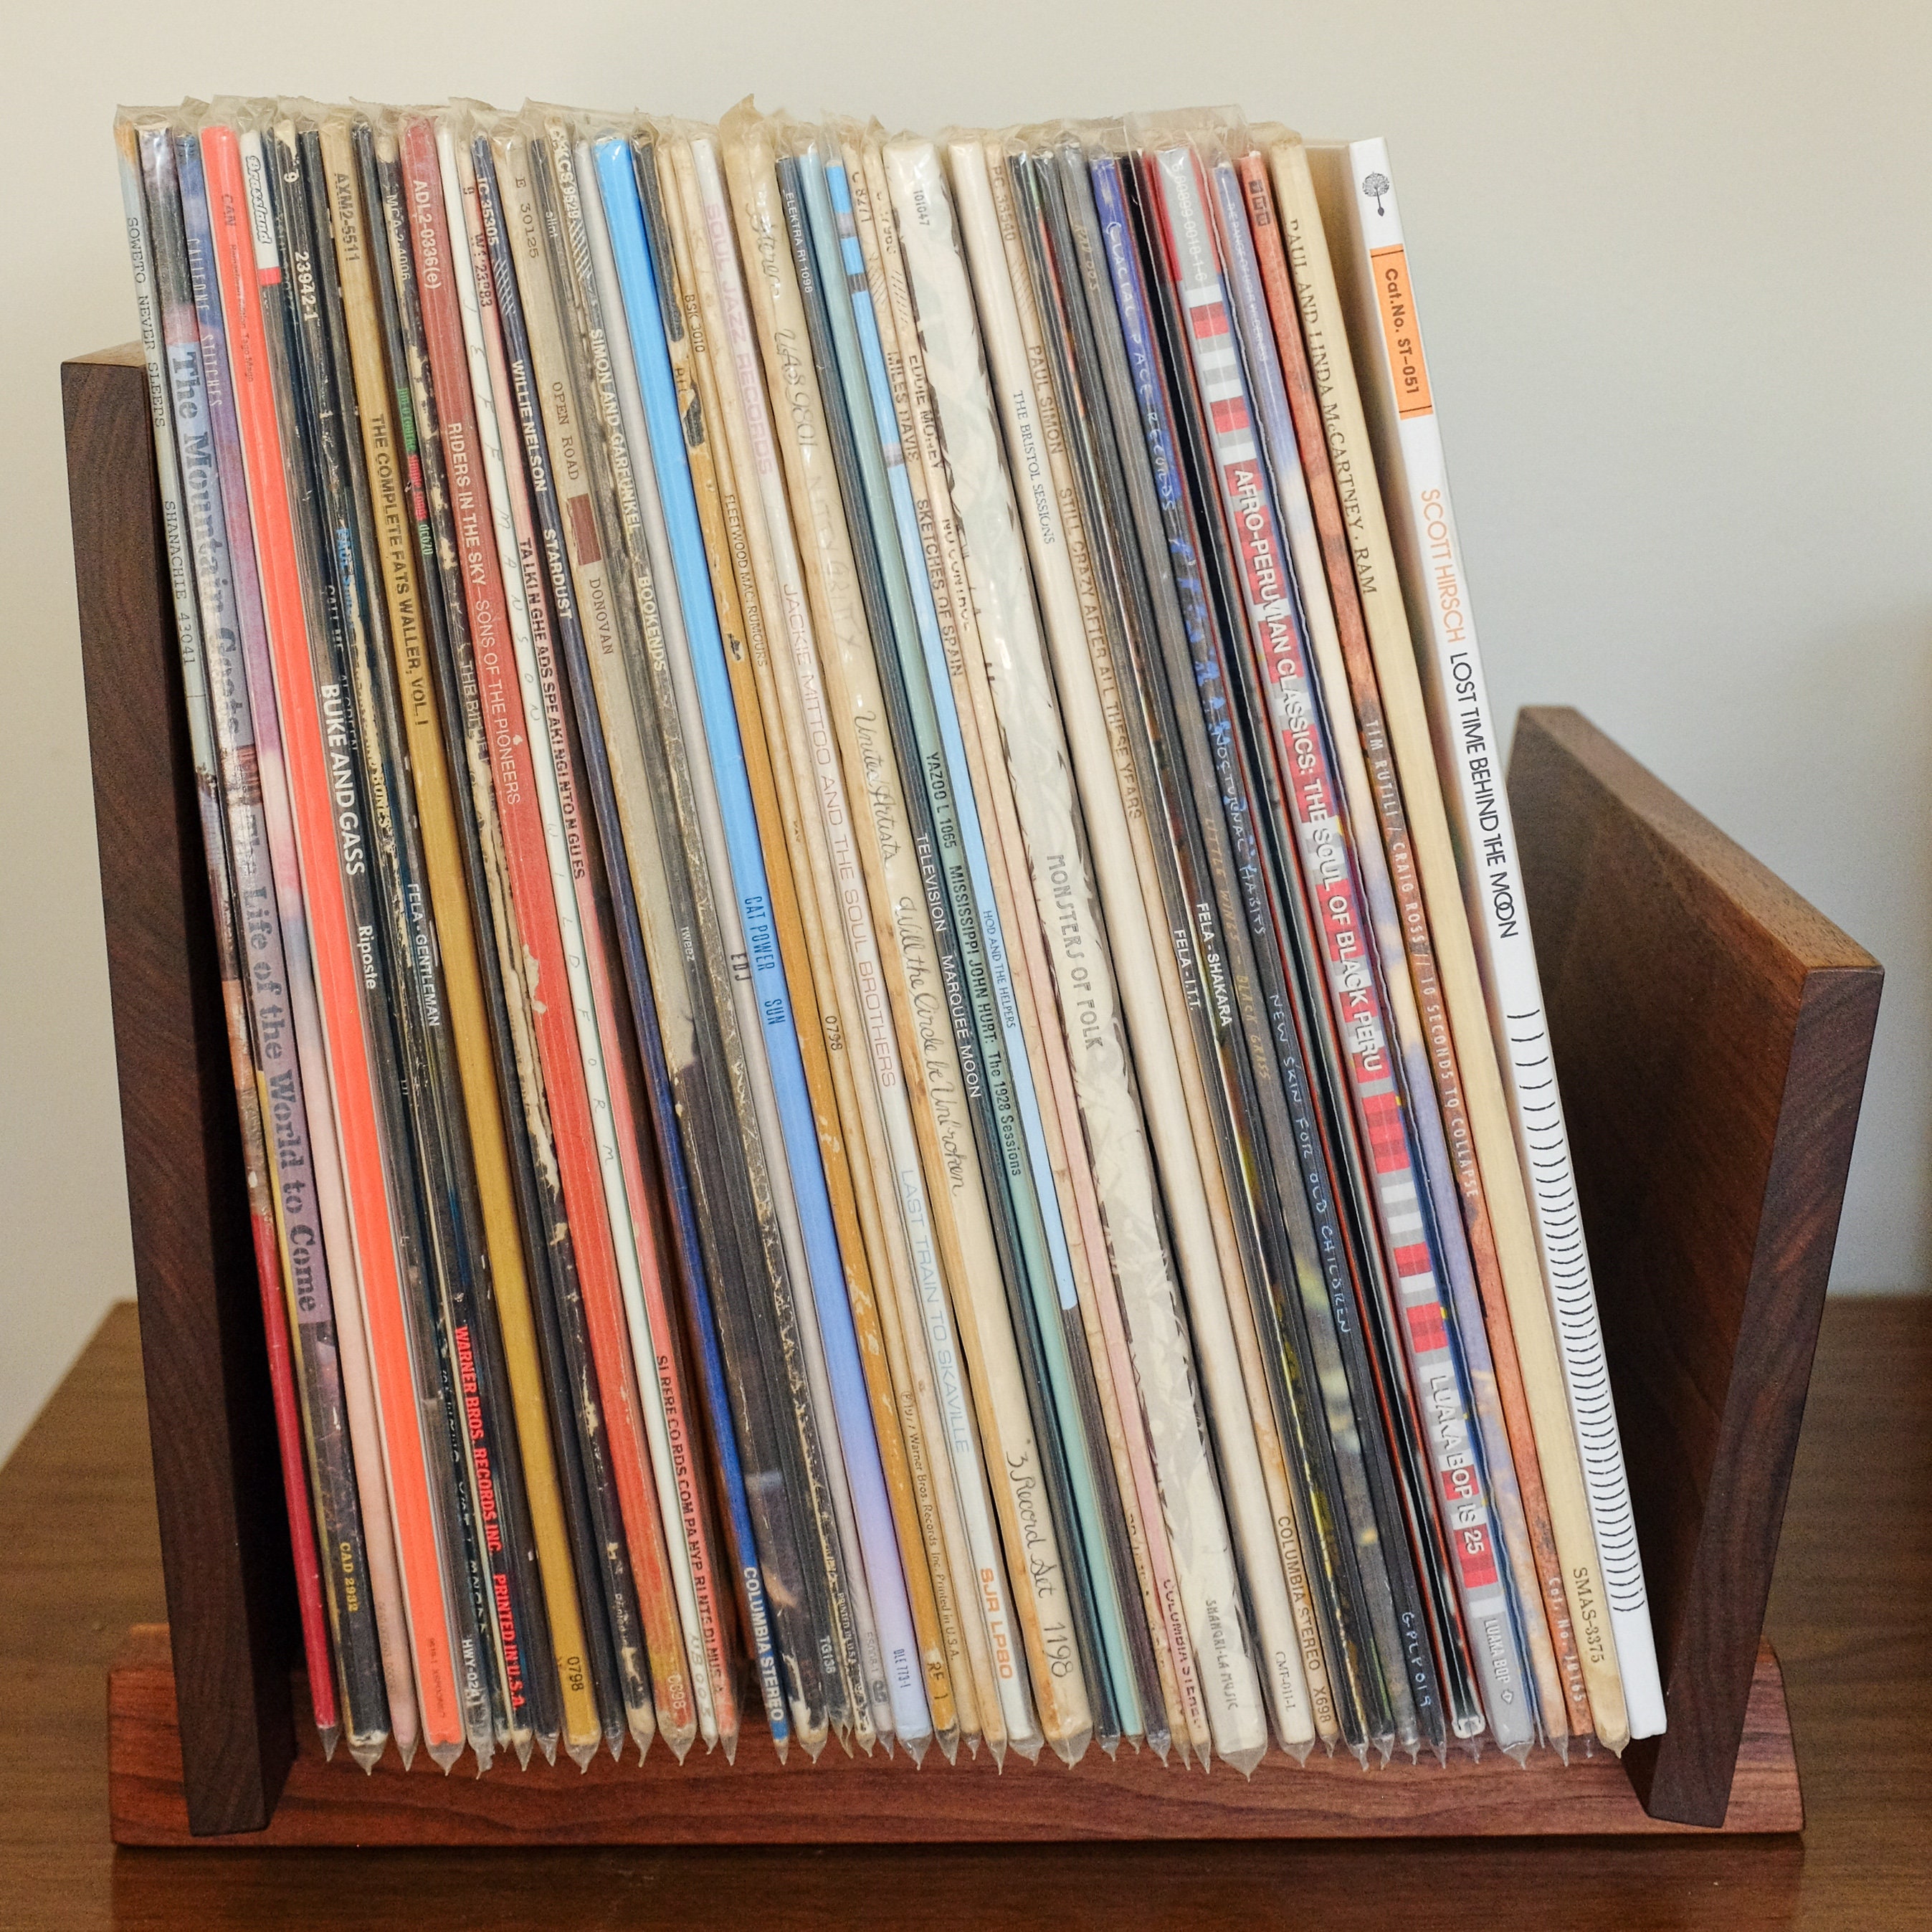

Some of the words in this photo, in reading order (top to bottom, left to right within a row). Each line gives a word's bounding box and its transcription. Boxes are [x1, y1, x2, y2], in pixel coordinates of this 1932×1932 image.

[220, 193, 237, 226] CAN
[331, 172, 361, 261] AXM2-5511
[406, 179, 445, 290] ADL2-0336(e)
[782, 191, 805, 245] ELEKTRA
[911, 189, 931, 226] 101047
[293, 251, 319, 321] 23942-1
[1382, 267, 1409, 333] Cat.No.
[588, 328, 613, 383] SIMON
[689, 323, 706, 353] 3010
[1395, 338, 1420, 394] ST-051
[171, 351, 206, 419] The
[1027, 345, 1051, 391] PAUL
[369, 414, 389, 448] THE
[479, 199, 500, 245] 35305
[510, 359, 533, 417] WILLIE
[522, 422, 548, 492] NELSON
[542, 529, 572, 619] STARDUST
[519, 203, 541, 259] 30125
[550, 381, 571, 425] OPEN
[561, 437, 581, 480] ROAD
[588, 578, 614, 655] DONOVAN
[600, 391, 621, 424] AND
[733, 353, 774, 475] RECORDS
[1010, 390, 1029, 419] THE
[1038, 397, 1064, 454] SIMON
[127, 217, 146, 282] SOWETO
[137, 295, 155, 350] NEVER
[146, 362, 165, 427] SLEEPS
[163, 501, 188, 599] SHANACHIE
[178, 612, 196, 664] 43041
[446, 423, 472, 486] RIDERS
[1017, 424, 1042, 480] BRISTOL
[1306, 331, 1336, 394] LINDA
[1321, 404, 1364, 530] McCARTNEY
[1352, 548, 1378, 594] RAM
[374, 453, 403, 545] COMPLETE
[457, 492, 475, 508] IN
[609, 434, 642, 533] GARFUNKEL
[1057, 487, 1082, 536] STILL
[179, 431, 233, 613] Mountain
[461, 513, 481, 546] THE
[1031, 484, 1056, 543] SESSIONS
[1419, 490, 1452, 558] SCOTT
[389, 551, 410, 594] FATS
[723, 494, 749, 568] FLEETWOOD
[744, 606, 768, 667] RUMOURS
[913, 498, 946, 590] SKETCHES
[940, 626, 964, 677] SPAIN
[1069, 541, 1095, 596] CRAZY
[1232, 470, 1292, 652] AFRO-PERUVIAN
[635, 576, 669, 671] BOOKENDS
[781, 584, 812, 665] JACKIE
[1082, 604, 1108, 658] AFTER
[1432, 566, 1467, 642] HIRSCH
[395, 600, 422, 675] WALLER,
[482, 653, 500, 675] OF
[486, 679, 507, 713] THE
[1447, 653, 1478, 702] LOST
[319, 685, 347, 746] BUKE
[799, 675, 832, 765] MITTOO
[1272, 657, 1318, 774] CLASSICS:
[1364, 720, 1385, 751] TIM
[1457, 707, 1487, 753] TIME
[492, 718, 522, 804] PIONEERS
[851, 710, 892, 786] United
[923, 751, 948, 800] YAZOO
[328, 752, 356, 808] AND
[819, 774, 844, 826] AND
[1117, 763, 1143, 819] YEARS
[1300, 782, 1329, 822] THE
[1372, 761, 1399, 817] RUTILI
[1466, 759, 1500, 831] BEHIND
[337, 812, 366, 875] GASS
[865, 781, 909, 870] Artists
[937, 818, 958, 848] 1065
[1479, 834, 1507, 865] THE
[830, 834, 855, 880] THE
[1310, 828, 1343, 890] SOUL
[1389, 842, 1415, 893] CRAIG
[242, 886, 275, 950] Life
[406, 883, 424, 921] FELA
[743, 895, 767, 918] CAT
[842, 889, 870, 952] SOUL
[946, 865, 980, 954] MISSISSIPPI
[1045, 855, 1085, 958] MONSTERS
[1194, 903, 1217, 941] FELA
[1324, 895, 1351, 925] OF
[1402, 902, 1425, 941] ROSS
[1486, 873, 1520, 938] MOON
[353, 925, 381, 989] Riposte
[729, 953, 752, 981] EDJ
[748, 925, 776, 970] POWER
[903, 955, 932, 989] the
[913, 832, 948, 932] TELEVISION
[938, 954, 971, 1039] MARQUEE
[958, 1044, 983, 1098] MOON
[986, 937, 1002, 961] AND
[992, 963, 1007, 984] THE
[1172, 930, 1193, 968] FELA
[1332, 931, 1368, 1002] BLACK
[252, 962, 283, 995] of
[414, 935, 441, 1026] GENTLEMAN
[966, 958, 989, 998] JOHN
[1068, 967, 1092, 991] OF
[1205, 953, 1234, 1027] SHAKARA
[257, 1006, 291, 1060] the
[763, 999, 787, 1025] SUN
[824, 1015, 843, 1050] 0798
[856, 961, 898, 1088] BROTHERS
[976, 1003, 998, 1044] HURT:
[997, 986, 1017, 1029] HELPERS
[1075, 999, 1104, 1050] FOLK
[986, 1052, 1005, 1077] The
[1349, 1012, 1383, 1072] PERU
[1424, 1006, 1455, 1079] SECONDS
[266, 1069, 306, 1169] World
[992, 1082, 1012, 1111] 1928
[999, 1115, 1026, 1176] Sessions
[1448, 1118, 1480, 1196] COLLAPSE
[281, 1179, 311, 1212] to
[899, 1169, 925, 1227] LAST
[287, 1224, 325, 1311] Come
[913, 1234, 941, 1302] TRAIN
[1317, 1225, 1354, 1333] CHILDREN
[928, 1310, 948, 1341] TO
[454, 1326, 477, 1392] WARNER
[465, 1396, 485, 1445] BROS.
[935, 1349, 971, 1453] SKAVILLE
[1427, 1376, 1463, 1450] LUAKA
[472, 1448, 497, 1520] RECORDS
[1444, 1454, 1474, 1499] BOP
[905, 1432, 925, 1471] Warner
[933, 1573, 953, 1612] Printed
[1007, 1470, 1050, 1550] Record
[338, 1542, 354, 1572] CAD
[483, 1525, 503, 1555] INC.
[1460, 1528, 1485, 1553] 25
[343, 1577, 359, 1612] 2932
[978, 1568, 1001, 1612] SJR
[1026, 1552, 1064, 1600] Set
[491, 1574, 515, 1640] PRINTED
[1275, 1515, 1308, 1602] COLUMBIA
[1295, 1608, 1323, 1670] STEREO
[1311, 1687, 1333, 1722] X698
[1571, 1566, 1605, 1663] SMAS-3375
[741, 1566, 772, 1652] COLUMBIA
[758, 1657, 785, 1721] STEREO
[988, 1621, 1015, 1679] LP80
[1039, 1622, 1077, 1678] 1198
[1481, 1619, 1506, 1656] LUAKA
[505, 1665, 525, 1710] U.S.A.
[566, 1656, 585, 1690] 0798
